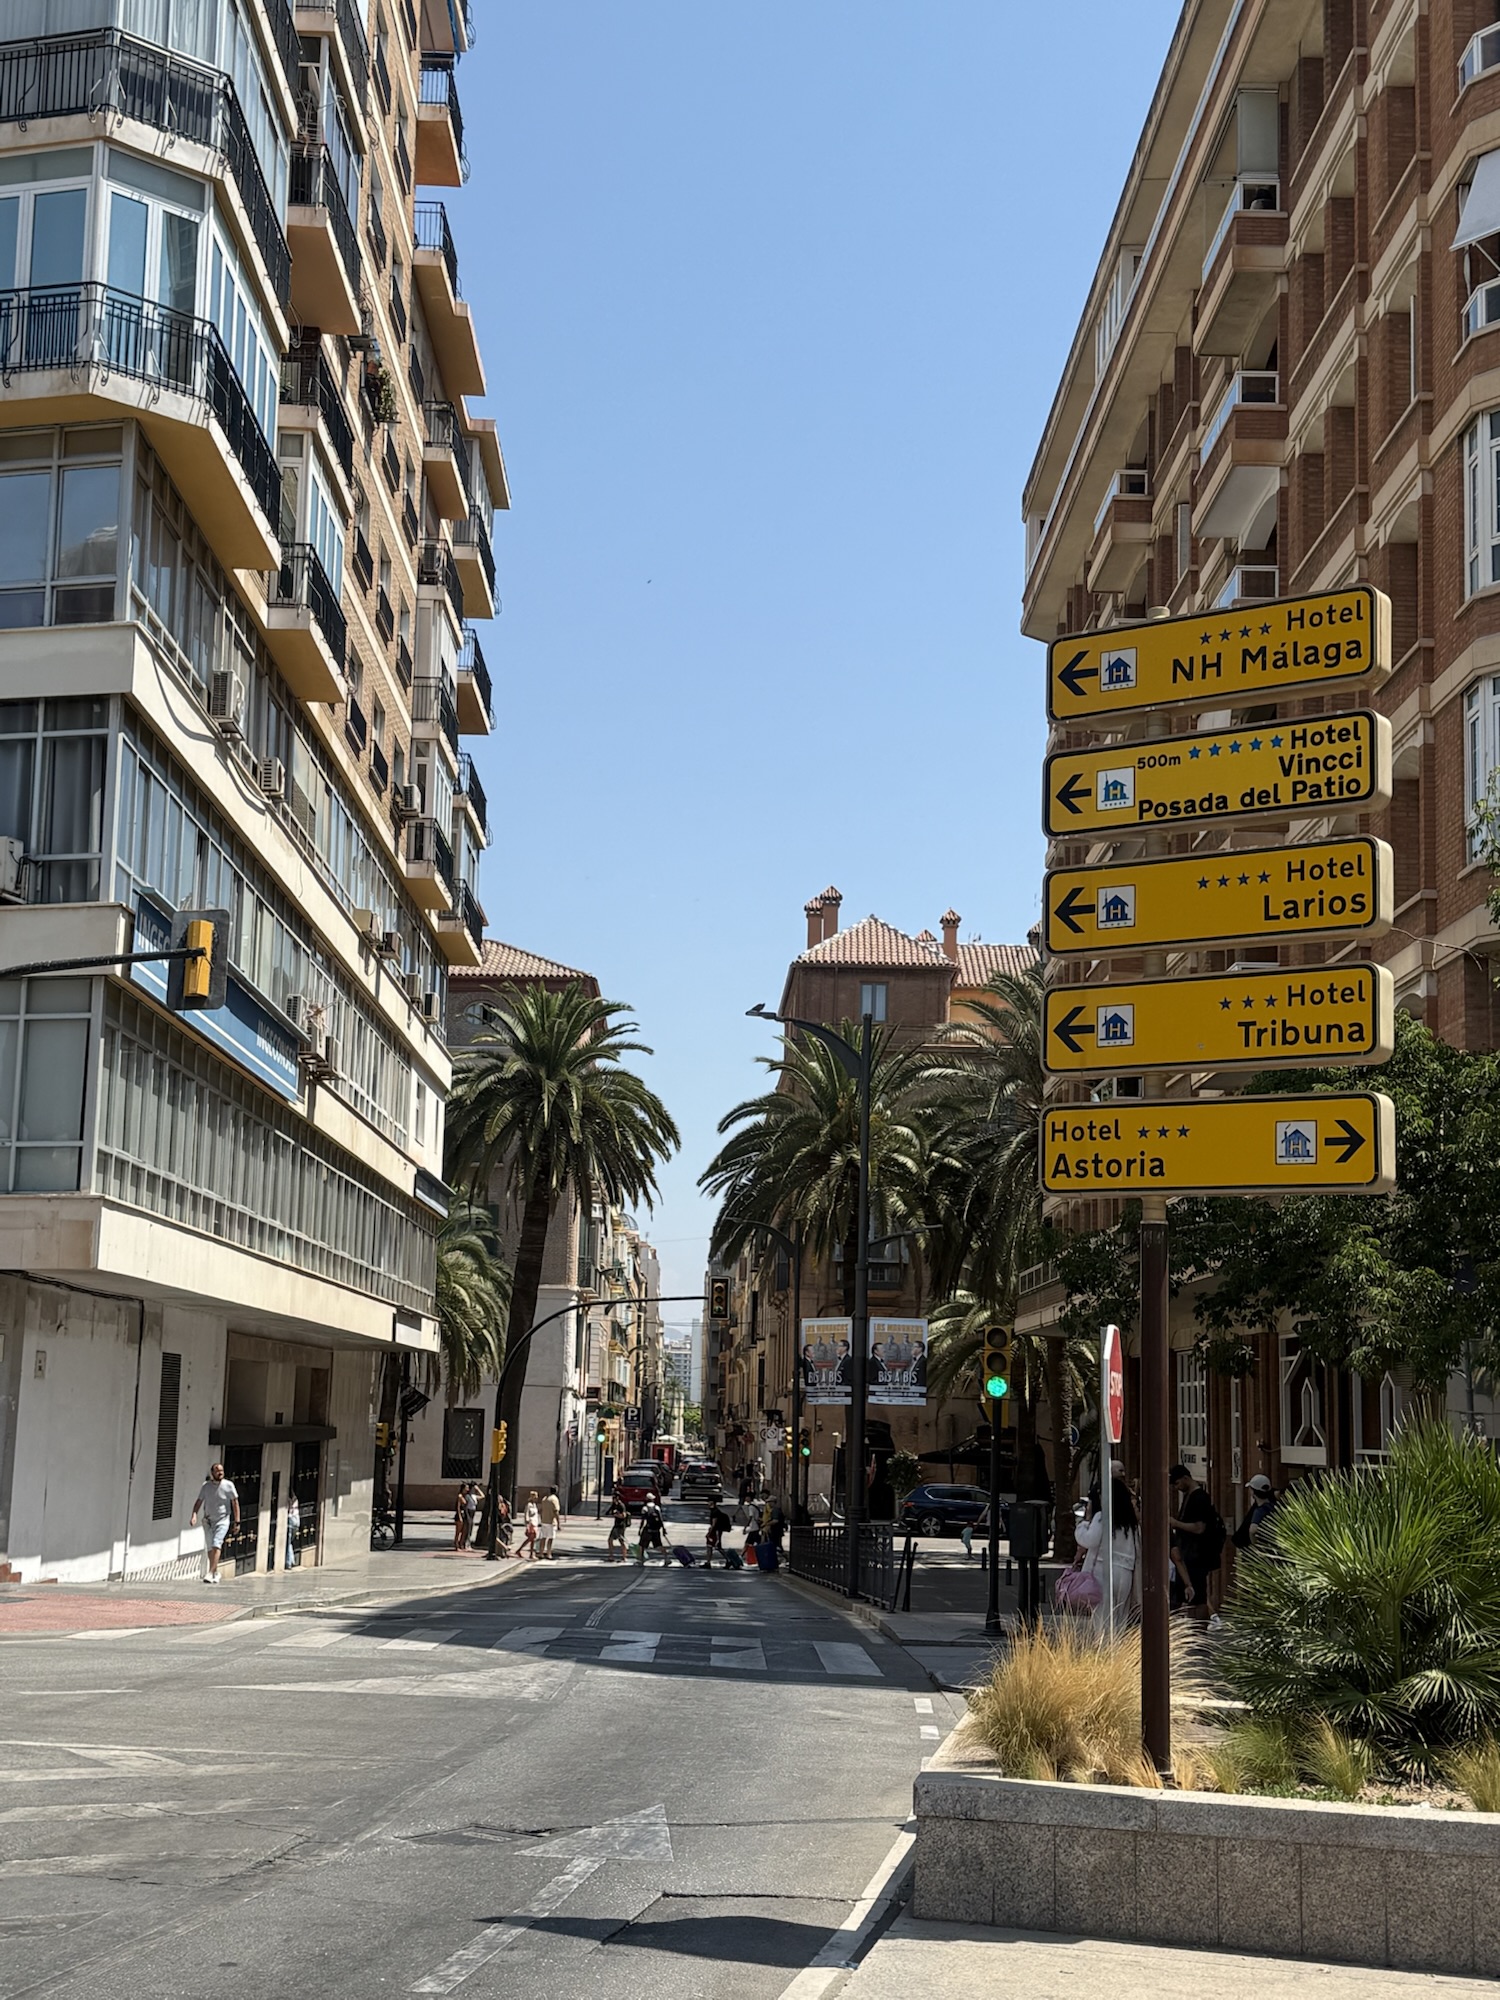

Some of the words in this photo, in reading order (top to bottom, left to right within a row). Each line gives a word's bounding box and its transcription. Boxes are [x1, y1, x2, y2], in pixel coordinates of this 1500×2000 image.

[1286, 599, 1364, 631] Hotel
[1172, 652, 1222, 684] NH
[1241, 639, 1363, 674] Málaga
[1137, 754, 1182, 770] 500m
[1290, 721, 1362, 749] Hotel
[1278, 747, 1363, 777] Vincci
[1138, 793, 1229, 820] Posada
[1240, 785, 1280, 812] del
[1292, 775, 1362, 802] Patio
[1286, 854, 1365, 883] Hotel
[1263, 890, 1367, 921] Larios
[1287, 980, 1366, 1007] Hotel
[1238, 1019, 1366, 1048] Tribuna
[1050, 1119, 1122, 1142] Hotel
[1050, 1151, 1165, 1179] Astoria
[903, 1370, 918, 1383] BIS
[1110, 1370, 1122, 1397] STOP
